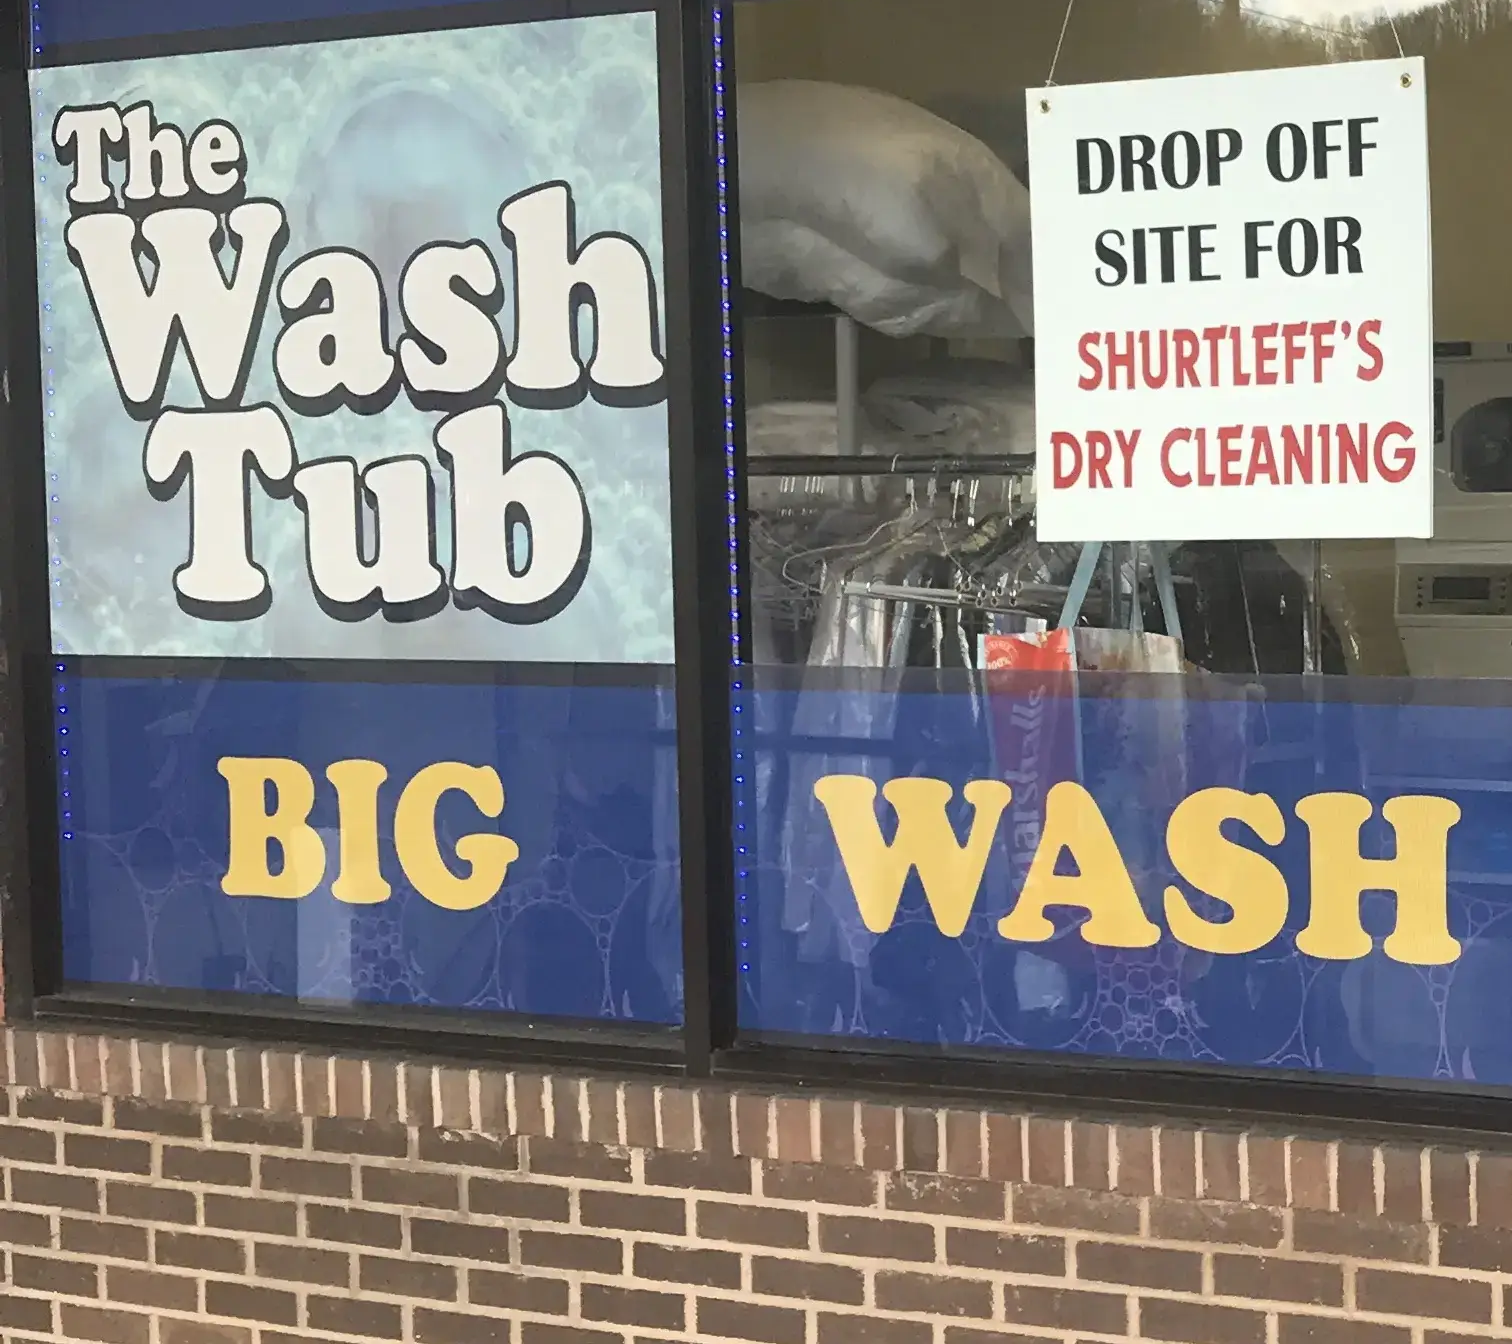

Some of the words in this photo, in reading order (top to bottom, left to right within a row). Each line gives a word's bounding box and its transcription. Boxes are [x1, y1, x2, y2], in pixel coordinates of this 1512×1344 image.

[54, 102, 246, 211] The
[1076, 128, 1243, 195] DROP
[1265, 116, 1379, 183] OFF
[65, 180, 667, 421] Wash
[1094, 224, 1221, 287] SITE
[1244, 215, 1364, 280] FOR
[1077, 319, 1384, 391] SHURTLEFF'S
[1050, 430, 1142, 490] DRY
[1161, 421, 1417, 489] CLEANING
[143, 400, 592, 625] Tub
[216, 756, 520, 911] BIG
[814, 774, 1462, 966] WASH
